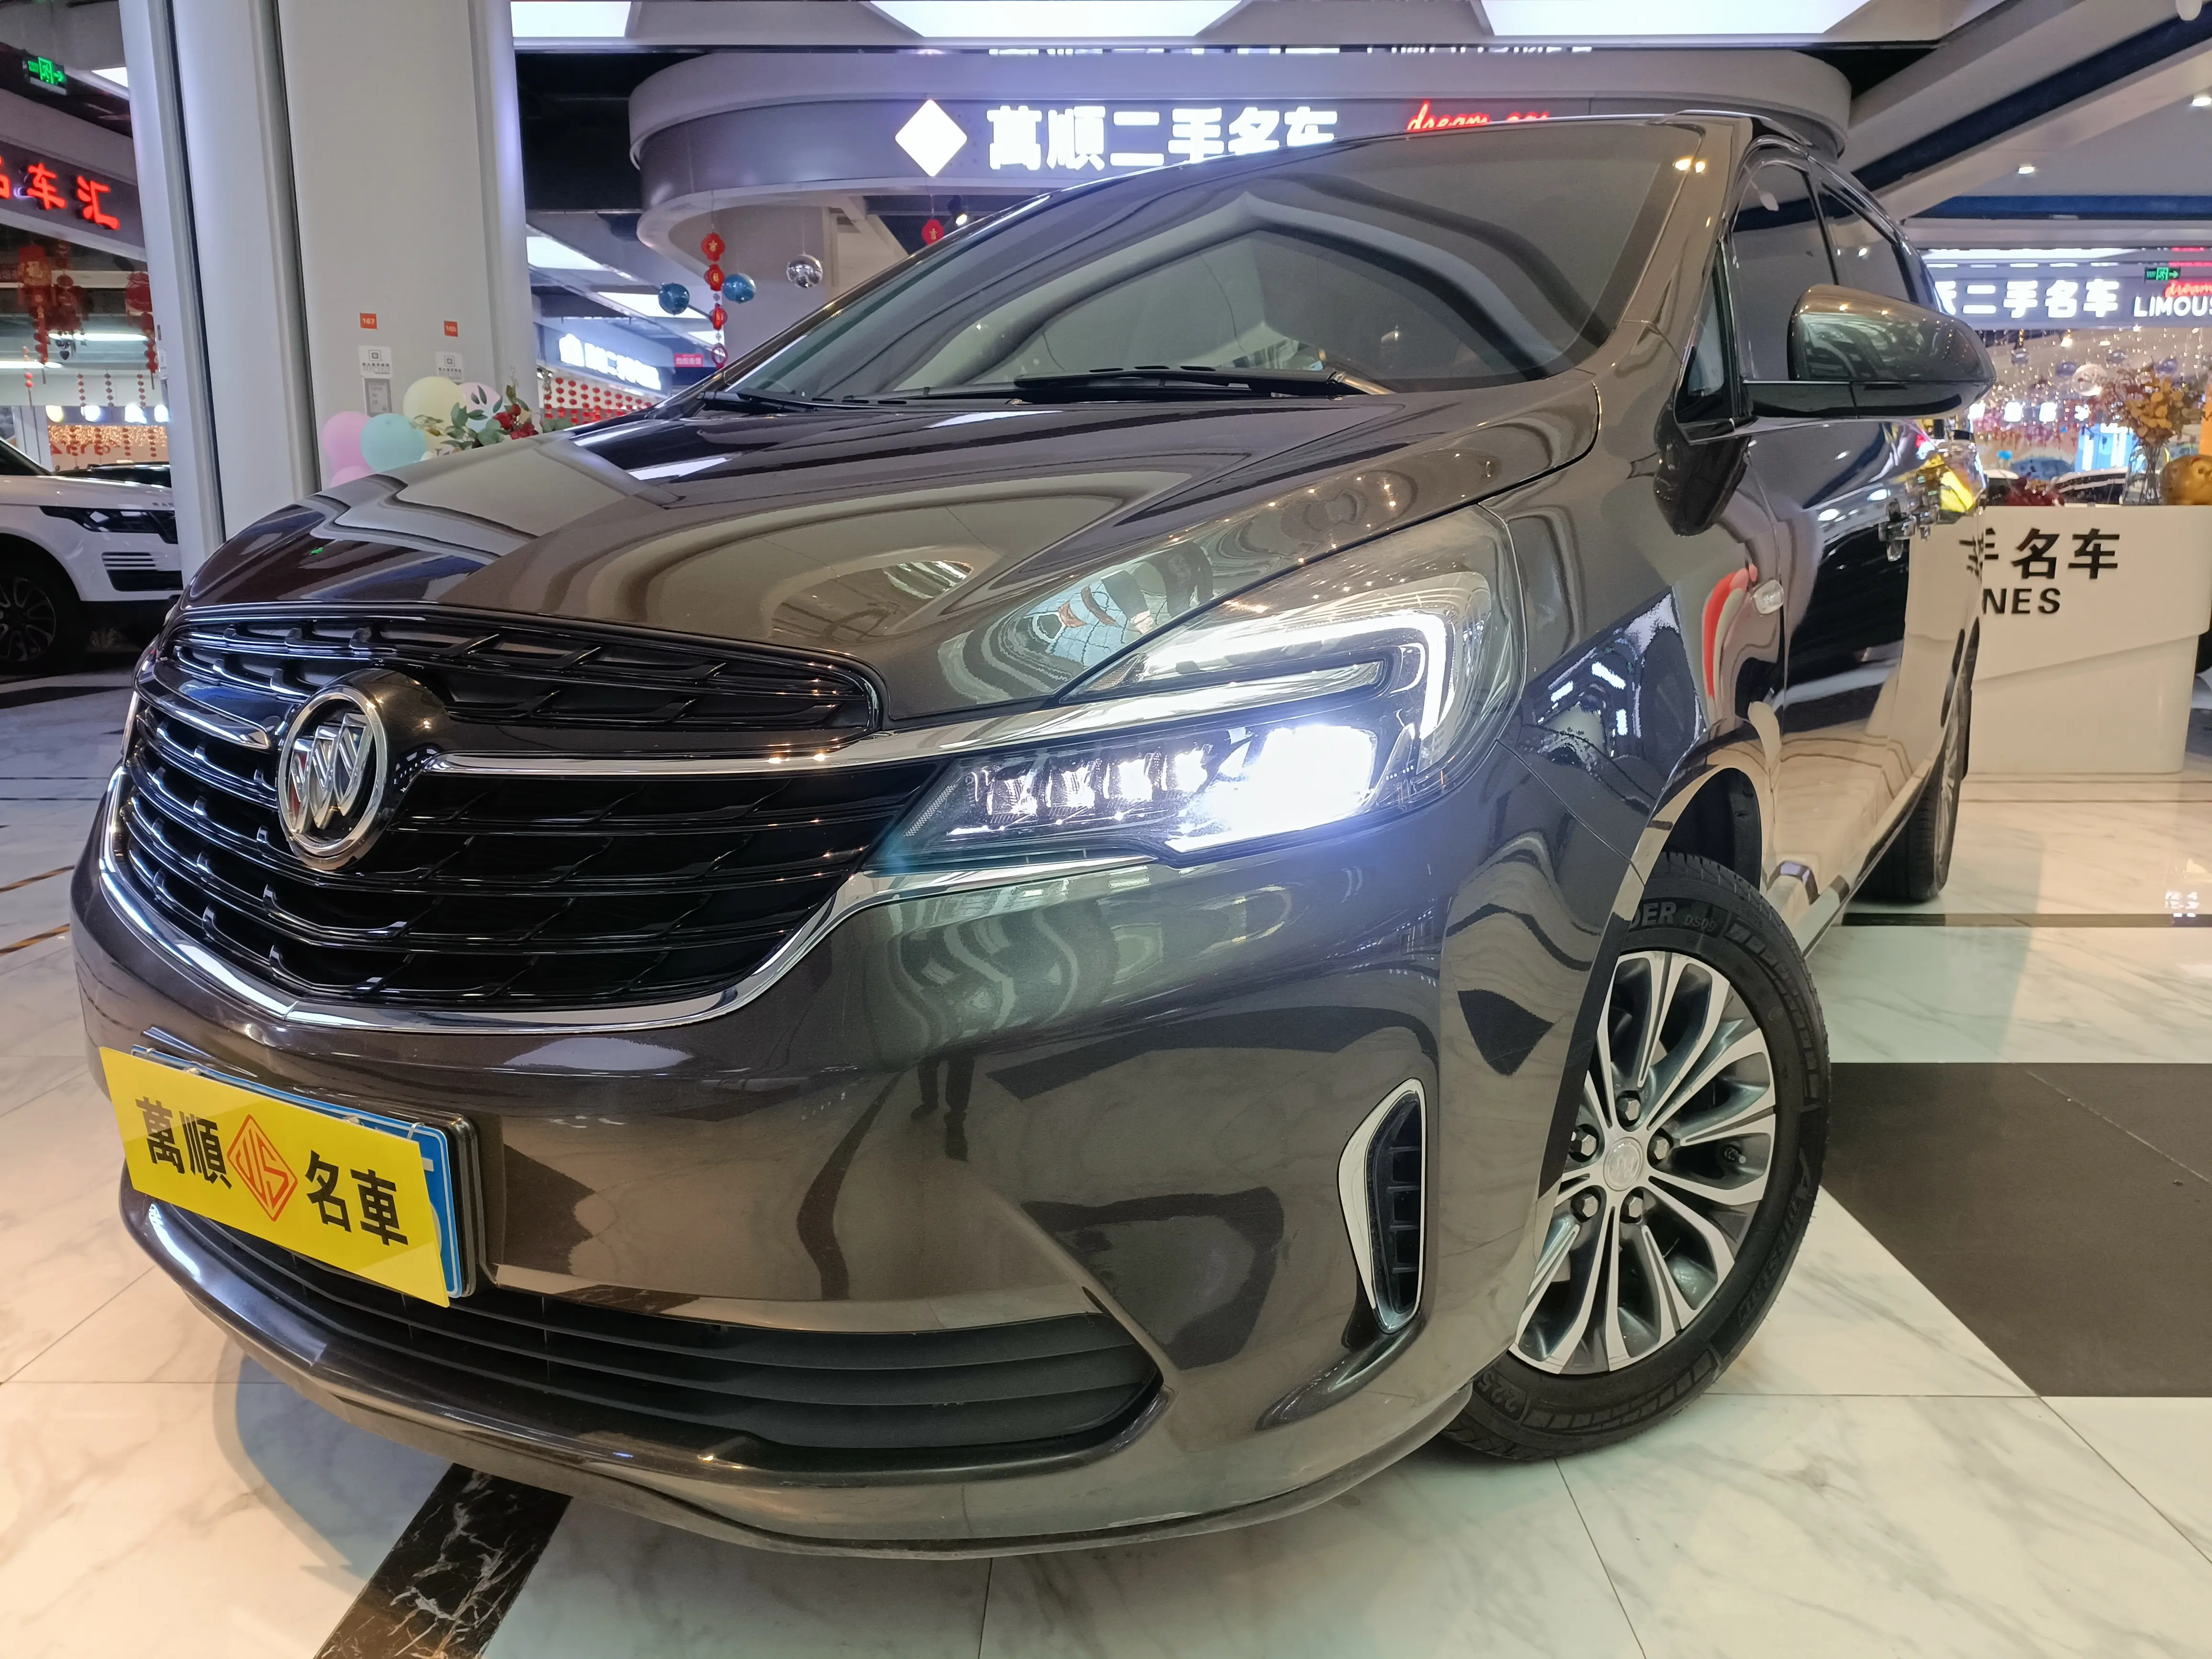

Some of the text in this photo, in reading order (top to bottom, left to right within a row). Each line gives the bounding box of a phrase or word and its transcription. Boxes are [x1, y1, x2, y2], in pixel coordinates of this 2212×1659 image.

[1406, 101, 1490, 131] dream
[2134, 296, 2212, 317] LIMOU
[1984, 527, 2120, 579] 名车
[135, 1096, 232, 1190] 萬順
[305, 1149, 409, 1246] 名車
